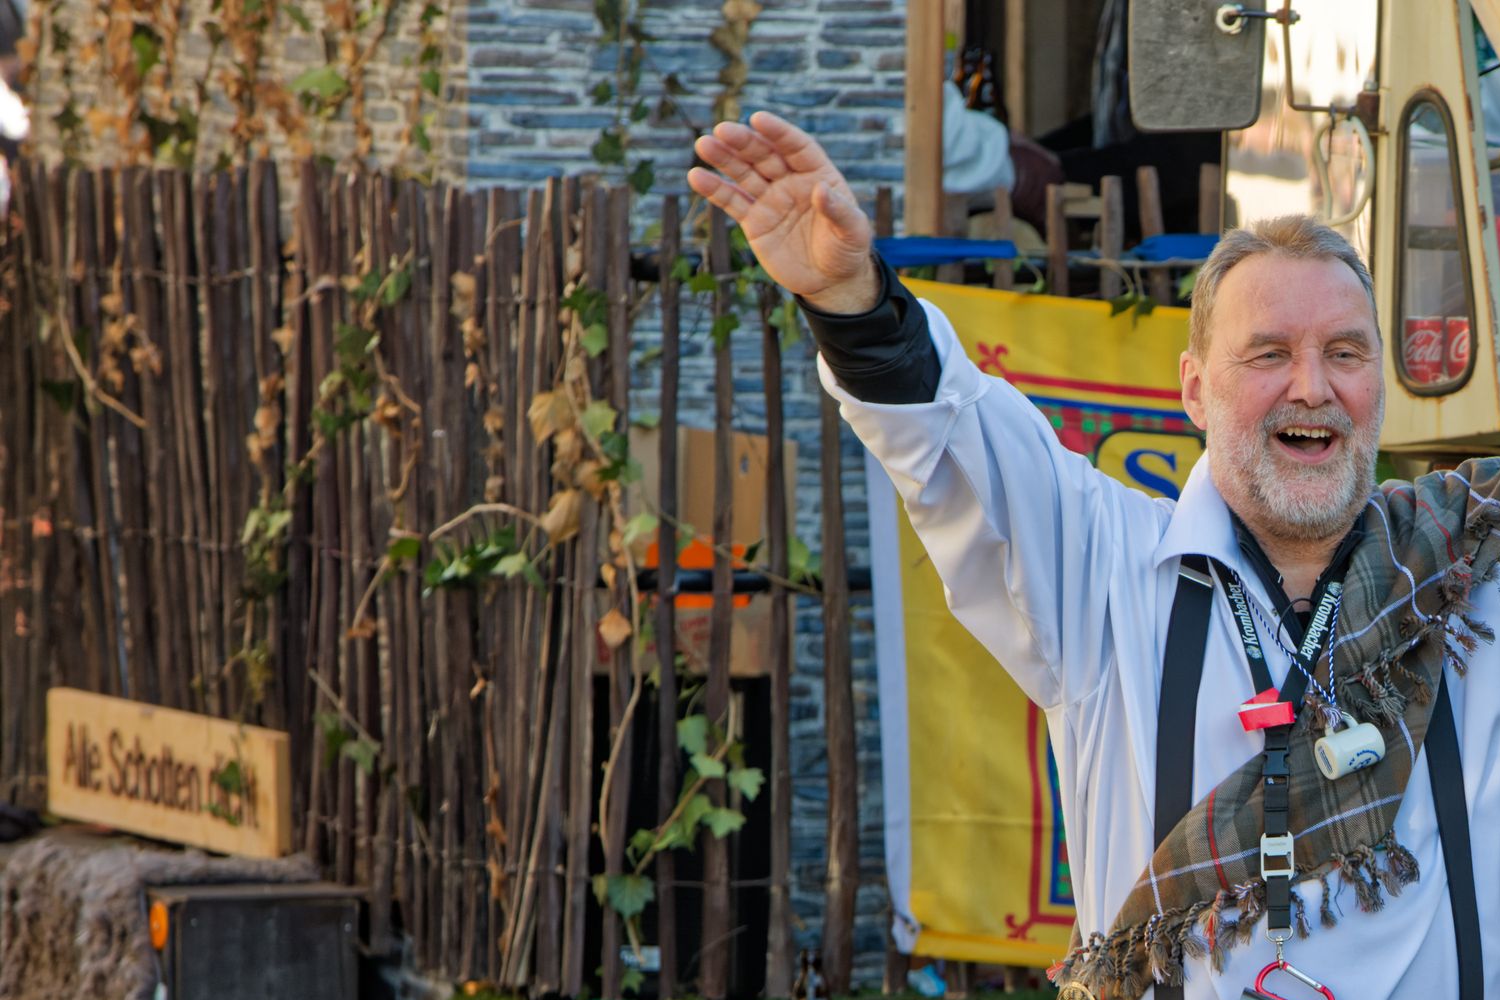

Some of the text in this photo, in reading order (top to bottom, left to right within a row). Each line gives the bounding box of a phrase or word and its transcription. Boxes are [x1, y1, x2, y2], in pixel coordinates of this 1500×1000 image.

[1228, 583, 1259, 646] Krombacher
[1300, 593, 1340, 661] Krombacher
[62, 720, 101, 792] Alle
[107, 728, 201, 814] Schotten
